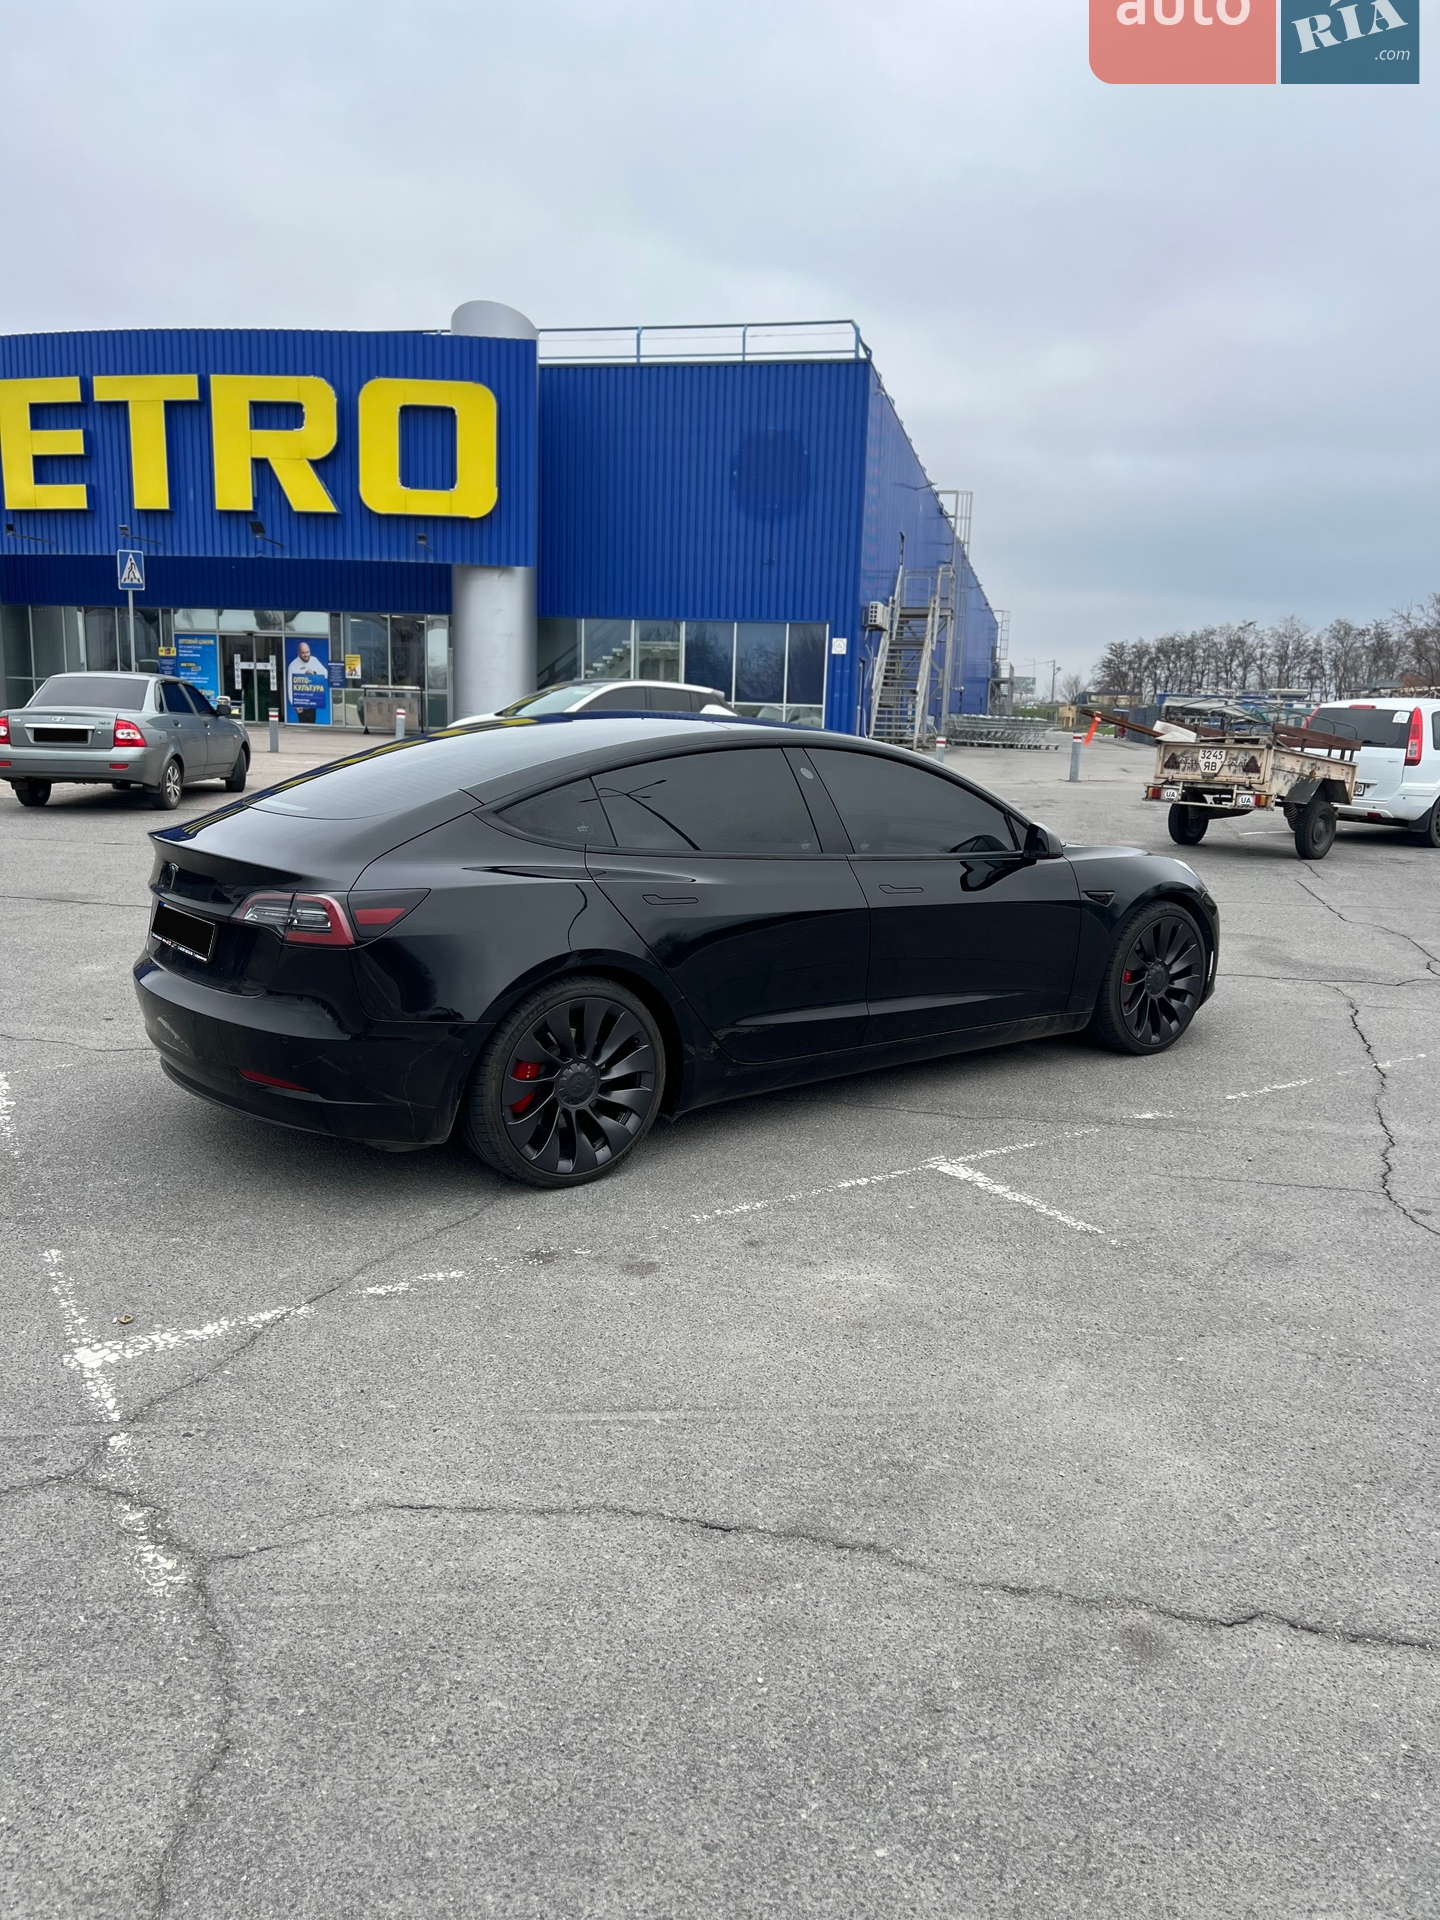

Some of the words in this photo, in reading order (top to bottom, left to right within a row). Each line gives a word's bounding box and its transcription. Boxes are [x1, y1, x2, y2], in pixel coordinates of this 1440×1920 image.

[0, 373, 498, 518] ETRO
[293, 676, 312, 684] ОПТО-
[293, 684, 324, 692] КУЛЬТУРА
[1200, 750, 1223, 760] 3245
